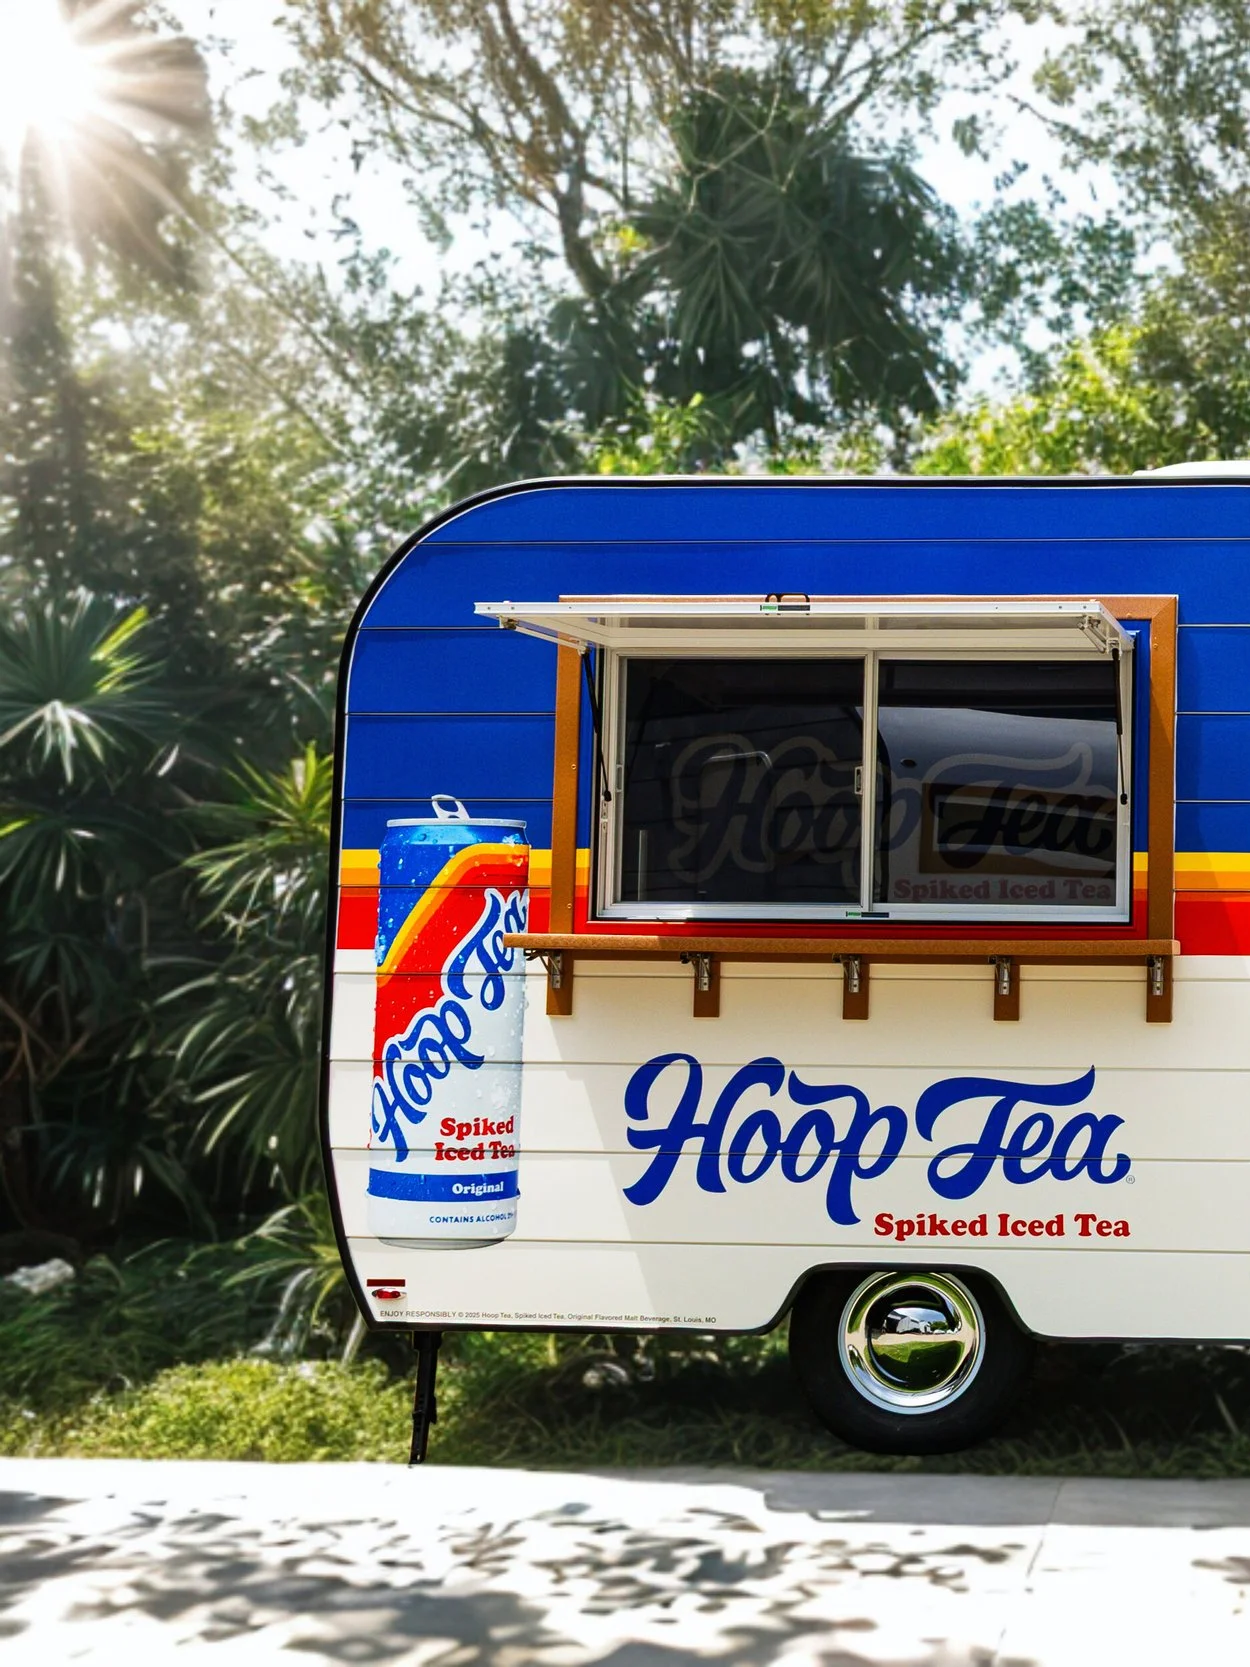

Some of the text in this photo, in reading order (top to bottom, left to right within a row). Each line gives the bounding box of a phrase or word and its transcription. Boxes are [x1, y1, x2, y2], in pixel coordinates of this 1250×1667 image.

[894, 879, 1112, 901] Spiked Iced Tea
[371, 999, 485, 1163] Hoop
[439, 1114, 515, 1141] Spiked
[622, 1052, 1132, 1226] Hoop Tea
[434, 1140, 515, 1161] Iced Tea
[451, 1180, 505, 1197] Original
[429, 1215, 474, 1224] CONTAINS
[475, 1213, 507, 1223] ALCOHOL
[873, 1213, 1131, 1242] Spiked Iced Tea
[379, 1310, 404, 1318] ENJOY
[405, 1310, 457, 1318] RESPONSIBLY
[481, 1312, 500, 1320] Hoop
[514, 1312, 537, 1321] Spiked
[567, 1313, 593, 1322] Original
[705, 1316, 717, 1324] MO
